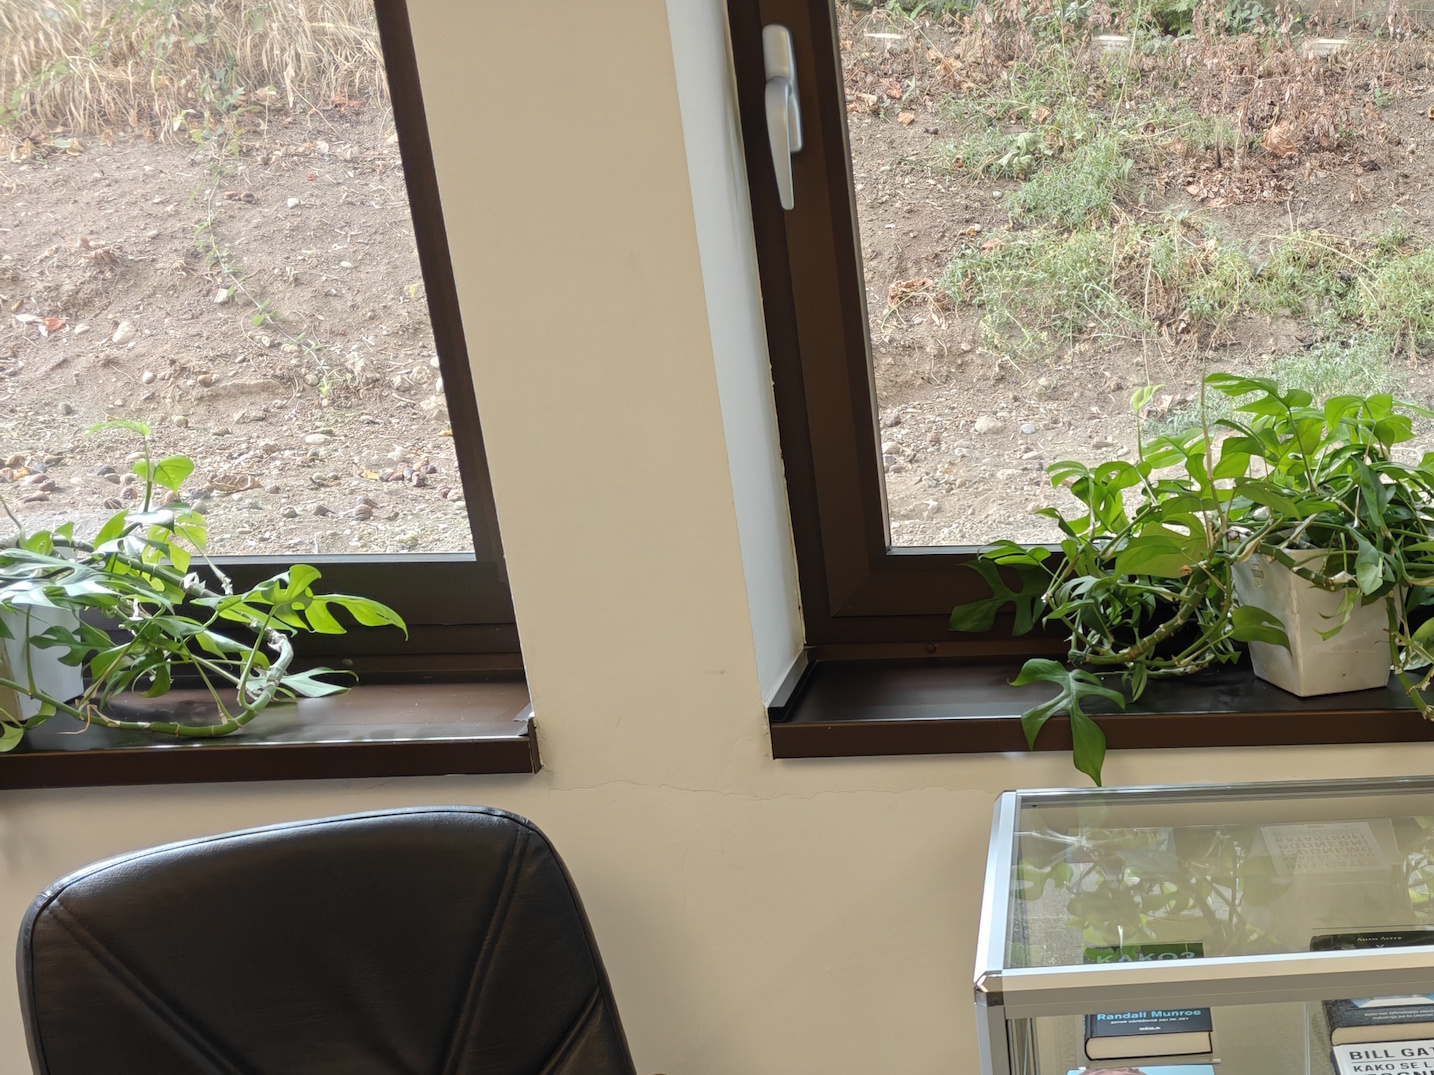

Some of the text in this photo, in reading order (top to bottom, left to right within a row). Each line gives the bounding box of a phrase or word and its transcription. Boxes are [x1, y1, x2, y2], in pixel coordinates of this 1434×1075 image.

[1096, 1010, 1202, 1021] Randall Munroe
[1349, 1049, 1395, 1060] BILL
[1353, 1063, 1395, 1072] KAKO
[1400, 1061, 1420, 1070] SE
